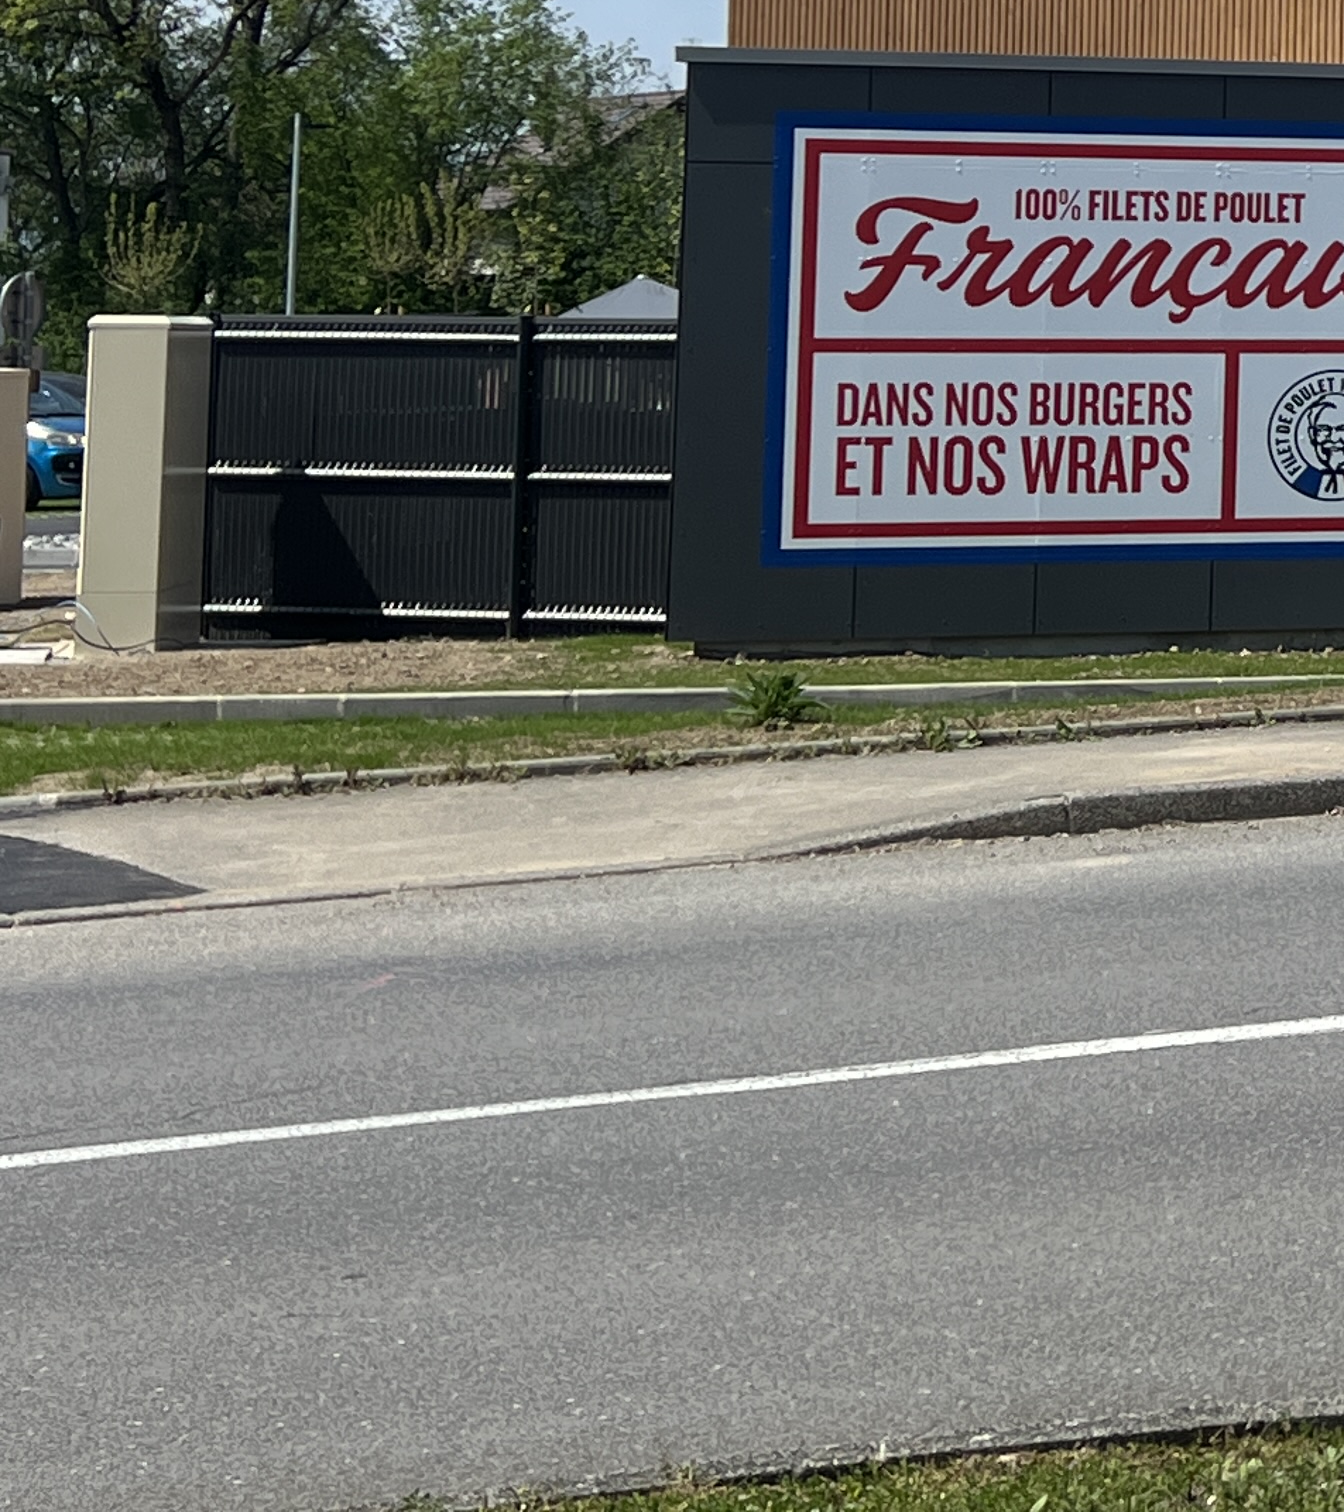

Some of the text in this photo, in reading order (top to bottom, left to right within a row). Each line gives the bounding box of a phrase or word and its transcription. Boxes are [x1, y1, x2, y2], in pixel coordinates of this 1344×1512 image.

[1015, 188, 1306, 223] 100% FILETS DE POULET
[836, 382, 1193, 427] DANS NOS BURGERS
[1284, 377, 1335, 414] POULET
[1275, 414, 1293, 434] DE
[835, 434, 1191, 496] ET NOS WRAPS
[1275, 438, 1302, 477] FILET
